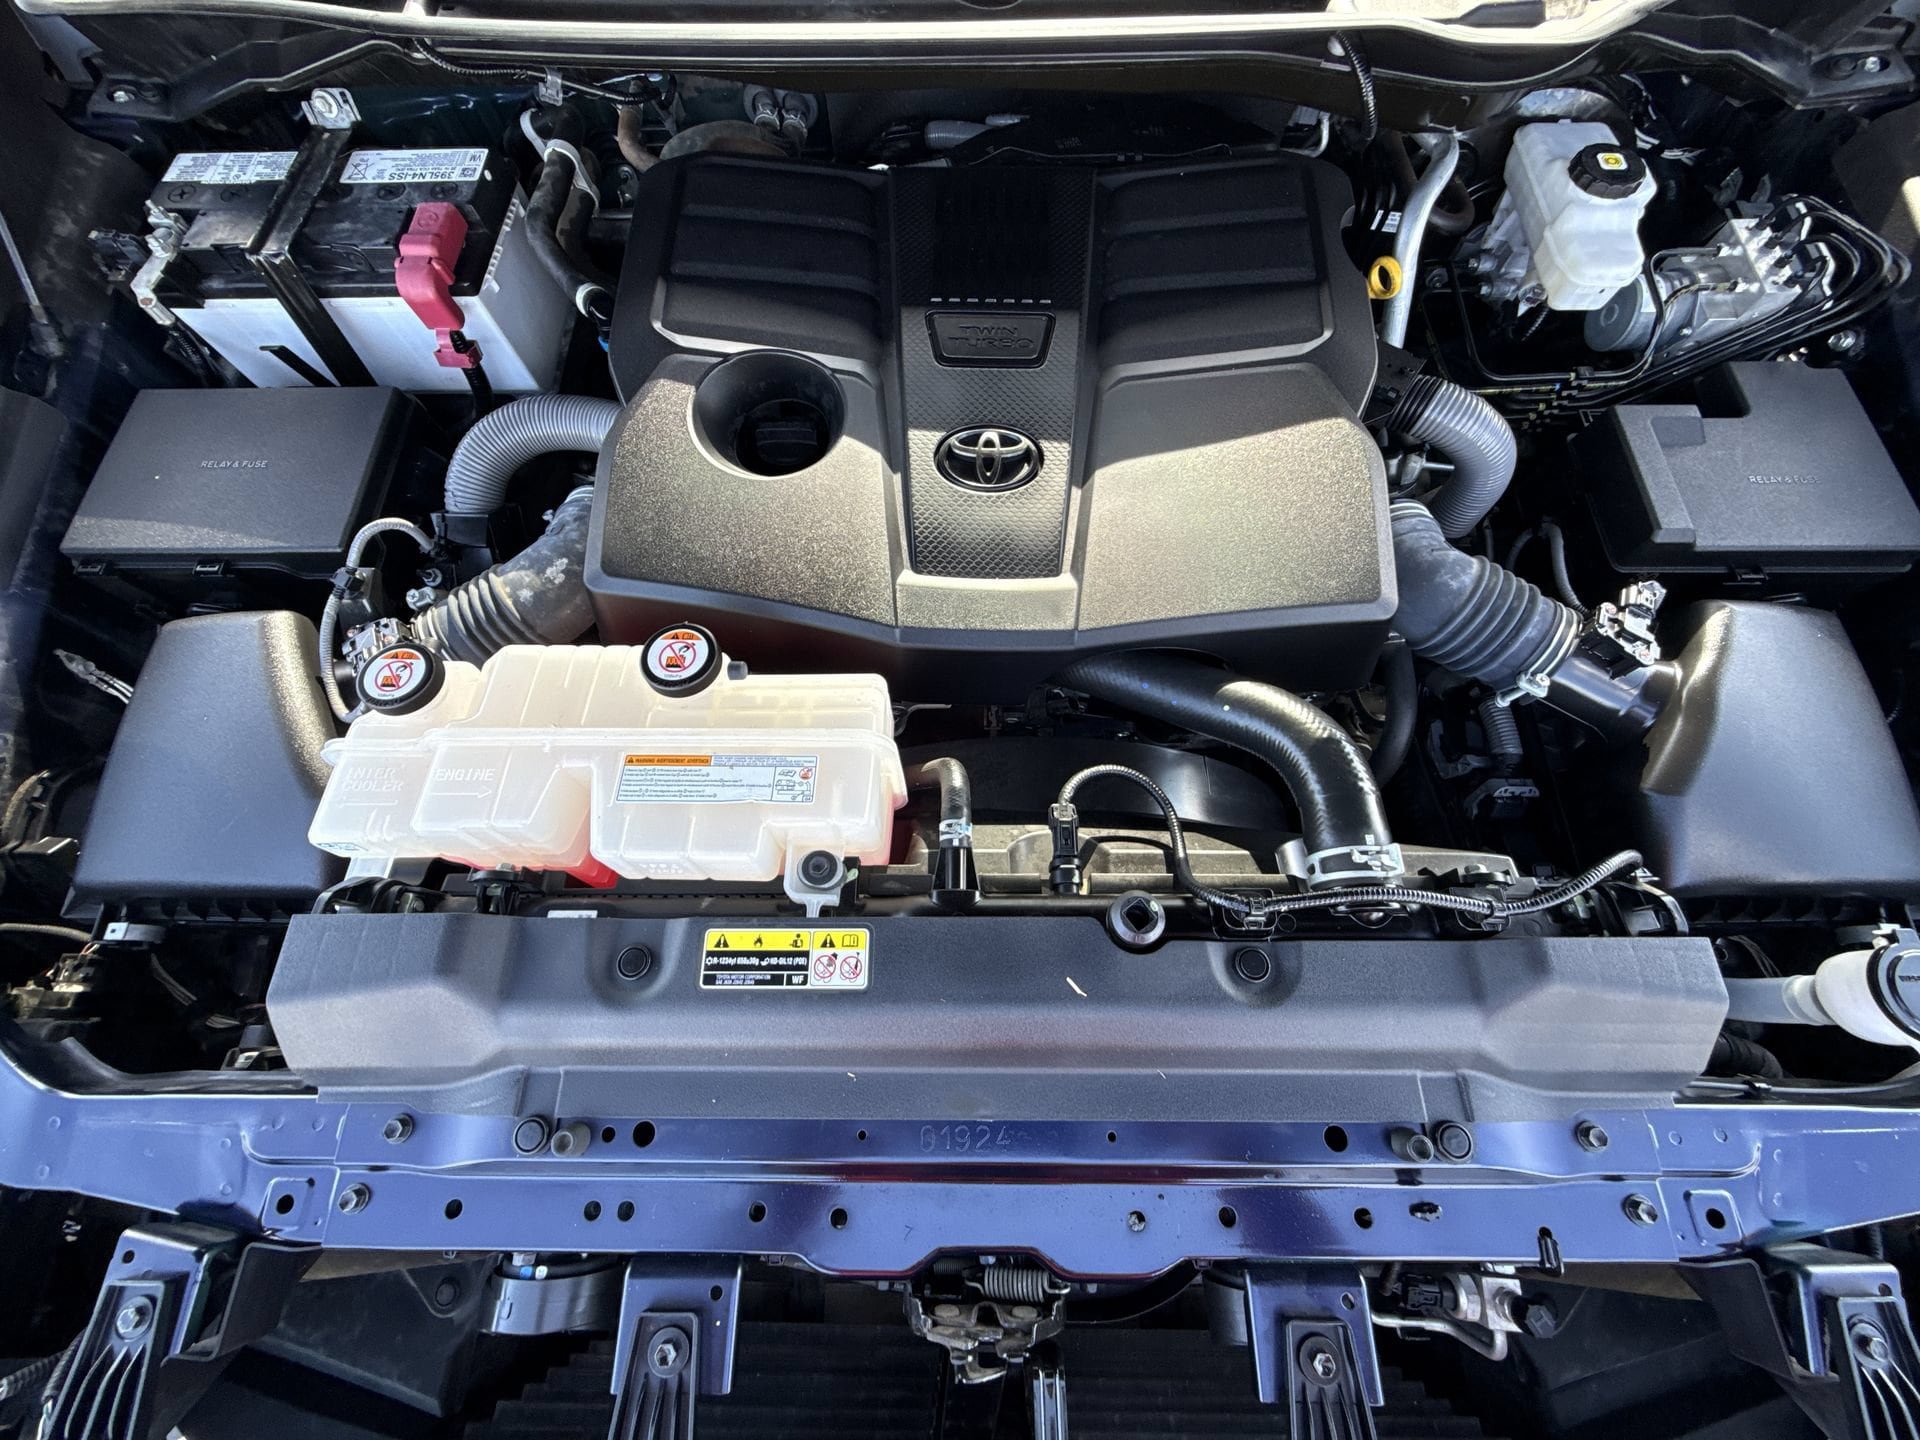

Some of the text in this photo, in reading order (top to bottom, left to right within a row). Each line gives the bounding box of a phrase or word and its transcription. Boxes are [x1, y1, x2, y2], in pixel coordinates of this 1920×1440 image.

[388, 171, 455, 181] 395LN4-ISS
[959, 325, 1019, 335] TWIN
[948, 337, 1035, 349] TURBO
[241, 460, 268, 468] FUSE
[1748, 475, 1782, 484] RELAY
[436, 768, 495, 781] ENGINE
[791, 975, 804, 984] WF
[920, 1124, 1012, 1152] 01924
